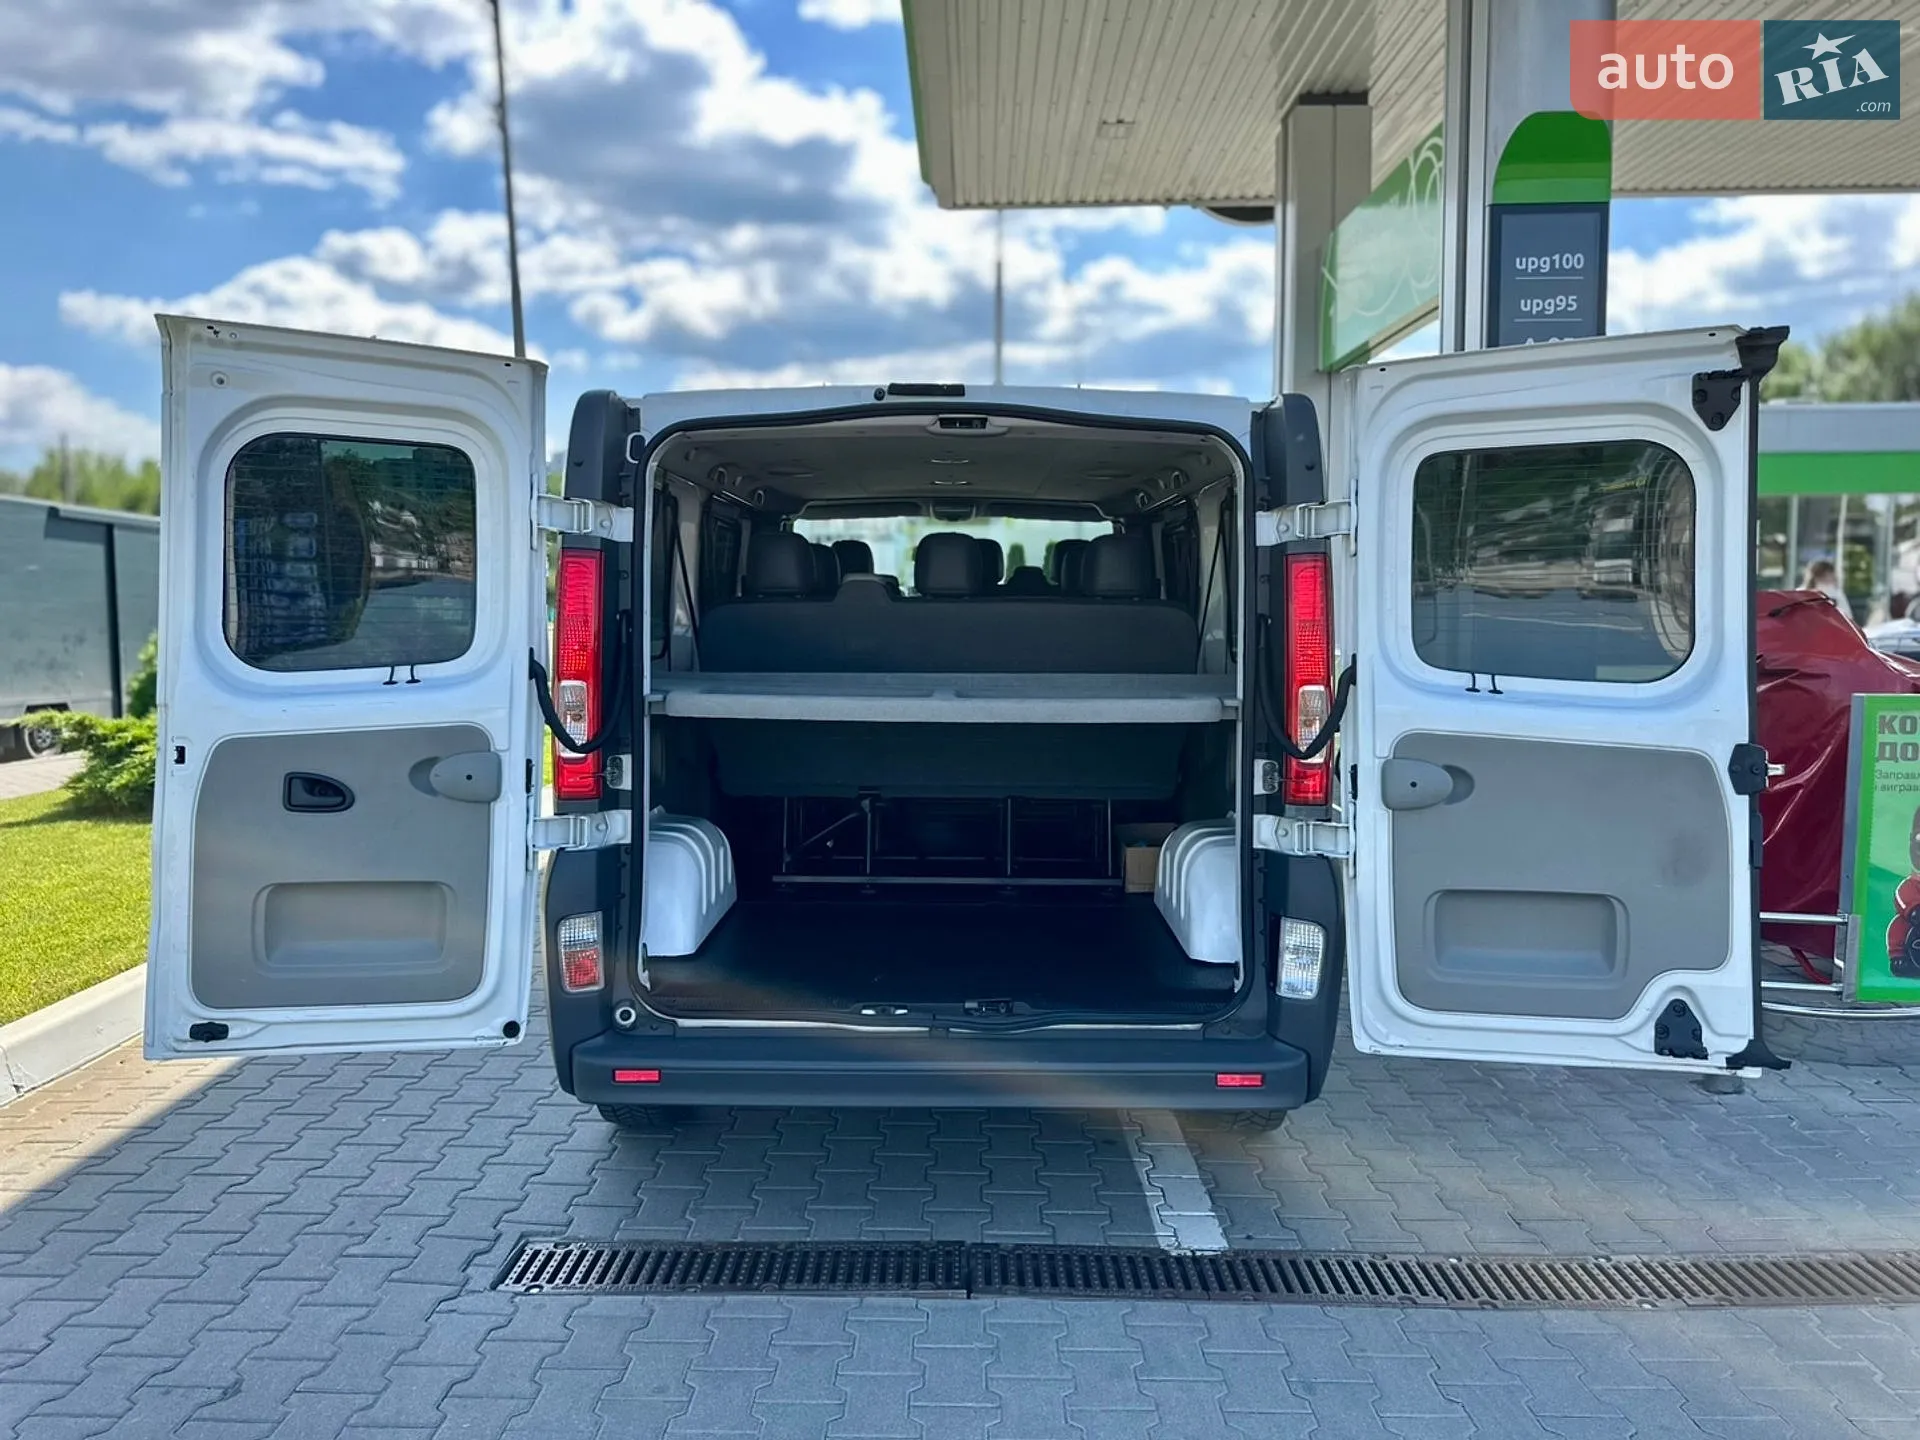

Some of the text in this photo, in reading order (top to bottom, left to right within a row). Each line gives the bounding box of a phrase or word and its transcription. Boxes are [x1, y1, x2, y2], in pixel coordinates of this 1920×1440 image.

[1515, 253, 1585, 273] upg100
[1520, 295, 1577, 315] upg95
[1878, 714, 1920, 735] КО
